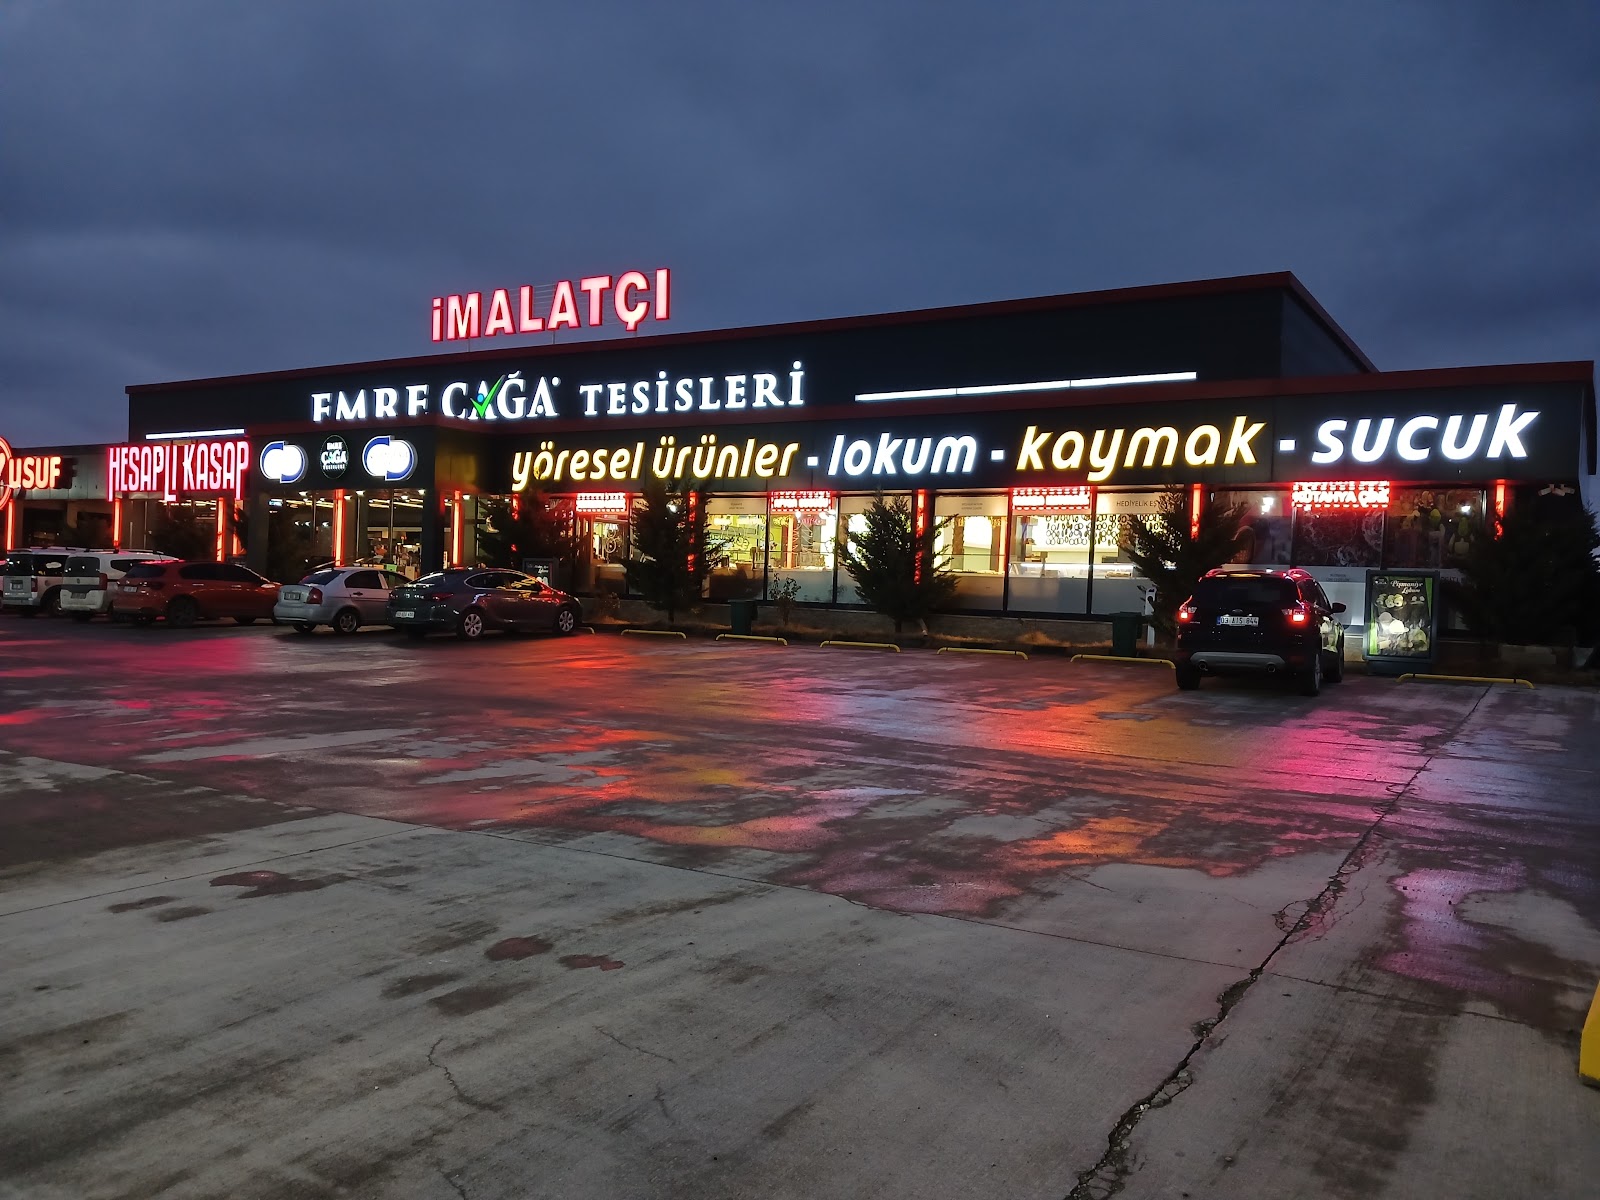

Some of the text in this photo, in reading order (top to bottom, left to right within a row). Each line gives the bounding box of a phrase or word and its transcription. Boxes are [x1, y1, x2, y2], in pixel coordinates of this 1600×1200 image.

[432, 268, 671, 342] İMALATÇI
[579, 360, 805, 416] TESİSLERİ
[108, 441, 250, 502] HESAPLI KASAP
[511, 441, 645, 491] yöresel
[652, 434, 799, 479] ürünler
[827, 433, 978, 476] lokum
[1016, 415, 1266, 482] kaymak
[1311, 403, 1540, 473] sucuk
[1116, 499, 1148, 507] HEDİYELİK
